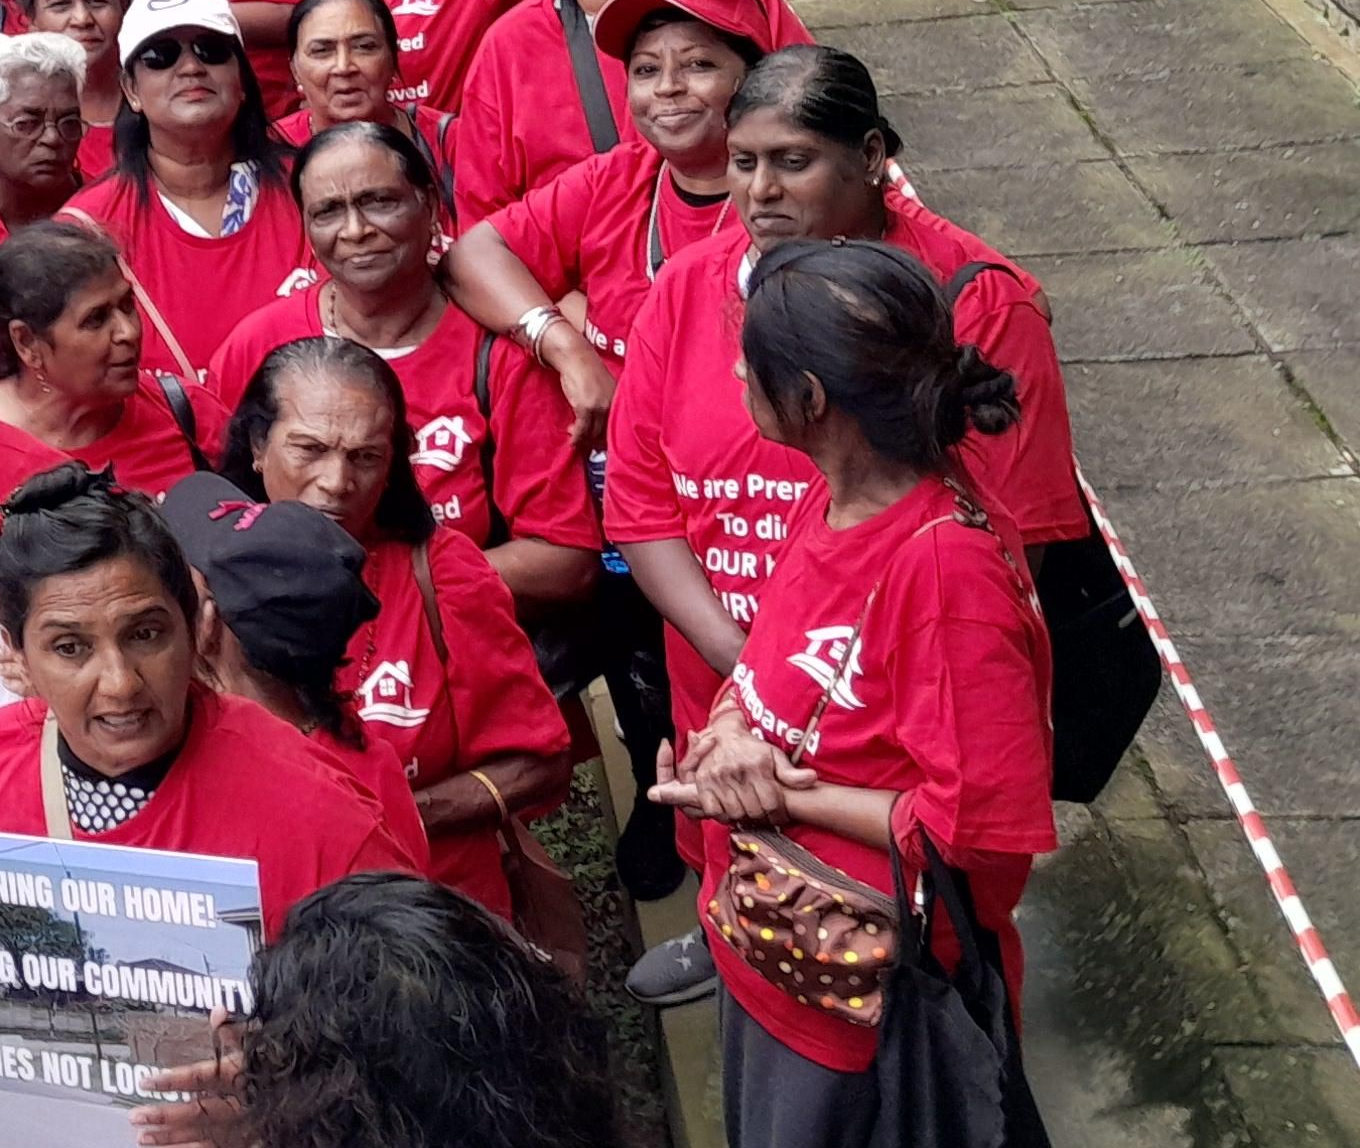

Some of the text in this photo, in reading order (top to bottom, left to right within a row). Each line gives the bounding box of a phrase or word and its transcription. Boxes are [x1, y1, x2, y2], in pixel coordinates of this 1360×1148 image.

[703, 478, 740, 500] are
[715, 512, 748, 536] To
[705, 547, 757, 578] OUR
[60, 878, 117, 916] OUR
[123, 884, 218, 929] HOME!
[21, 953, 78, 993] OUR
[40, 1050, 94, 1090] NOT
